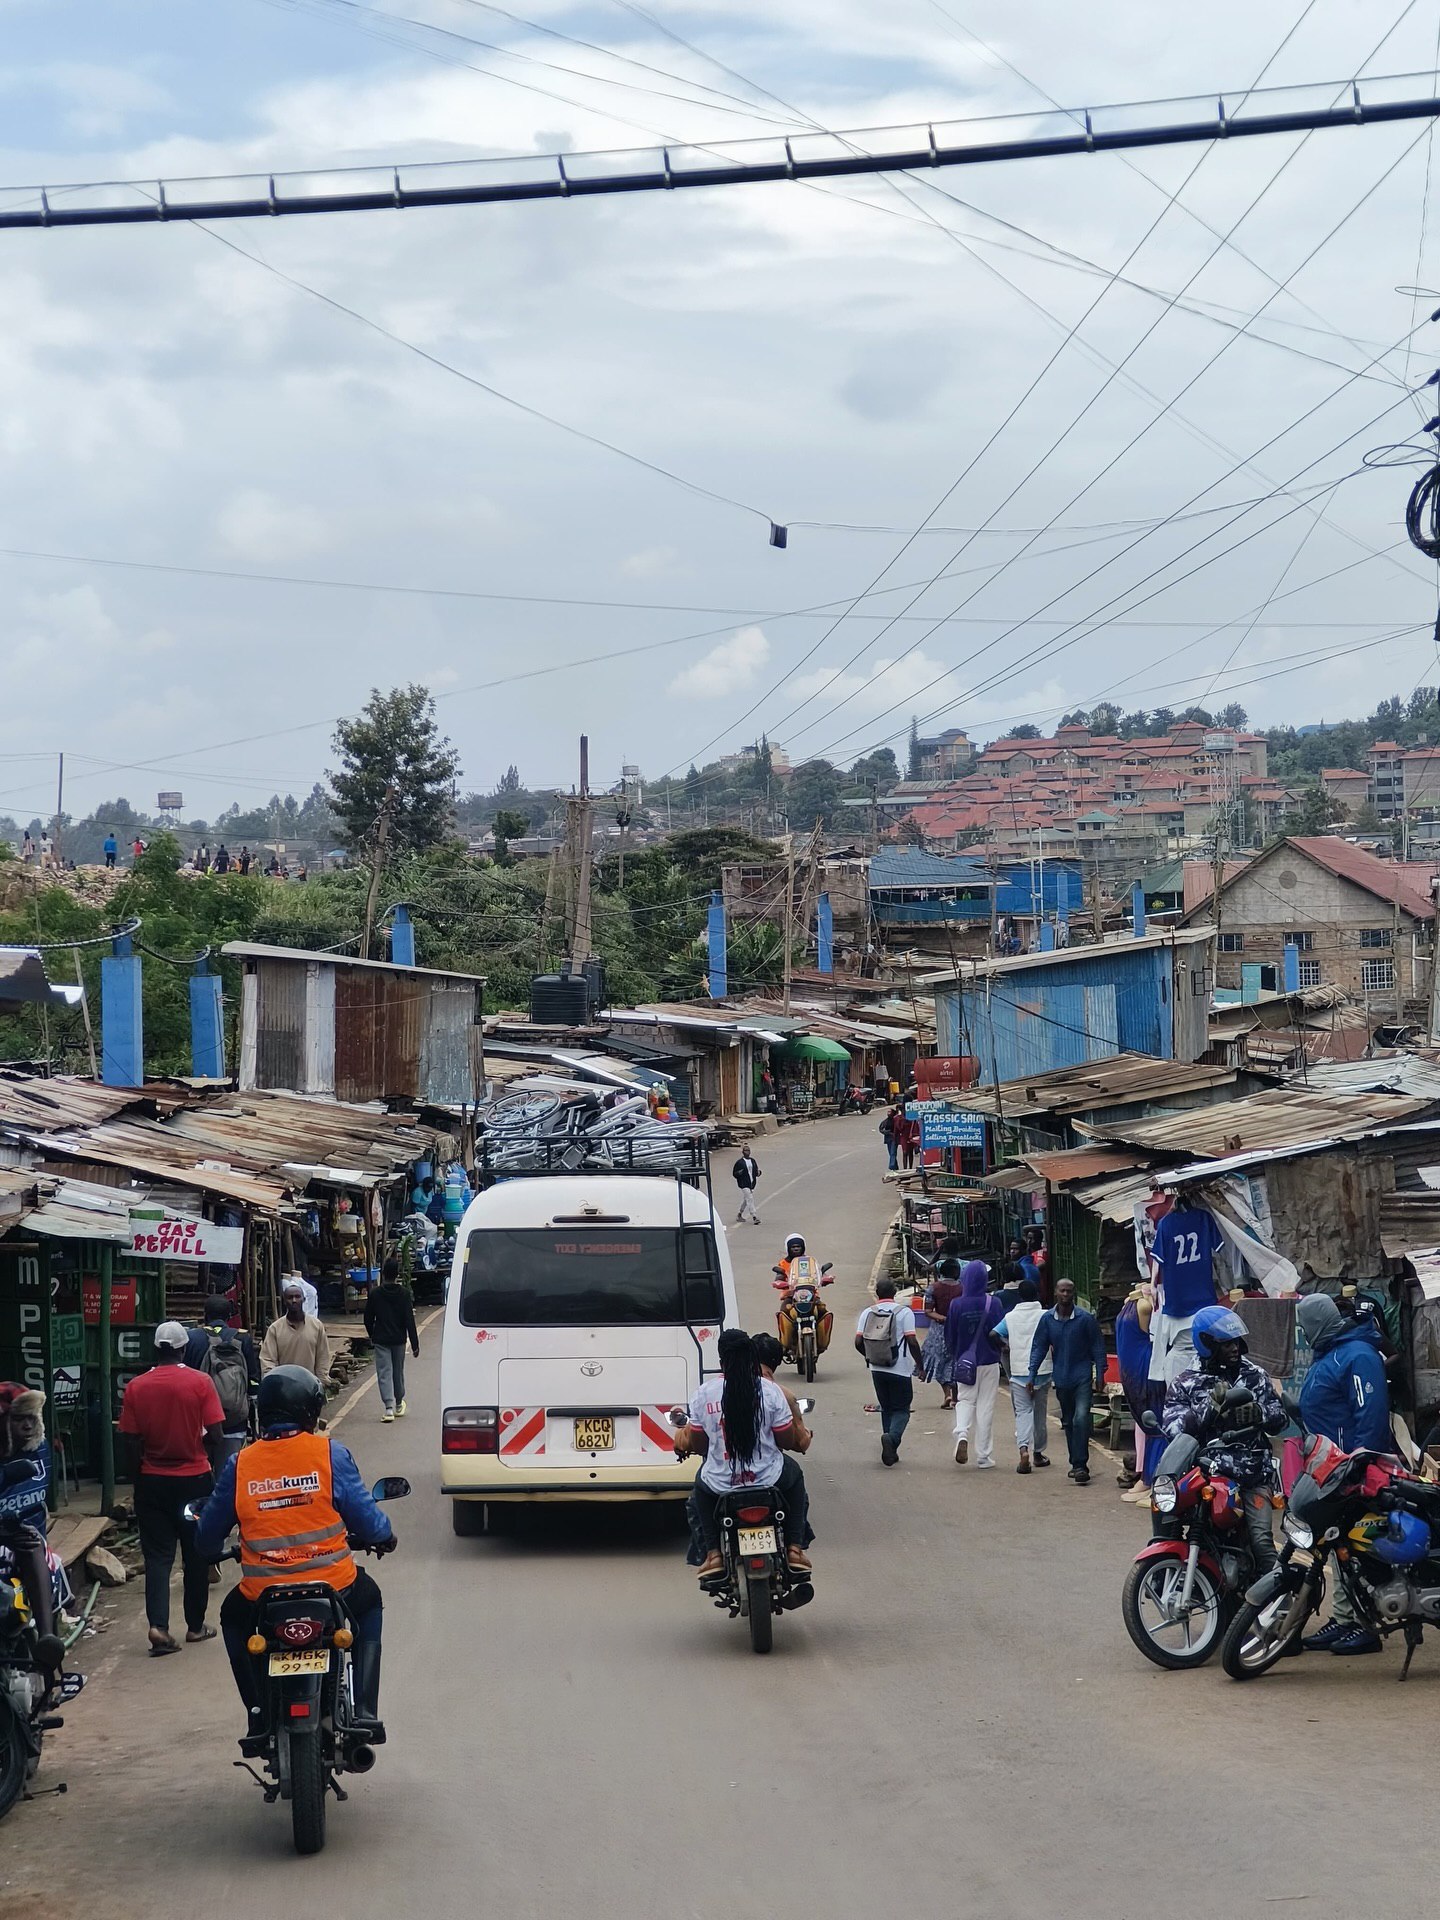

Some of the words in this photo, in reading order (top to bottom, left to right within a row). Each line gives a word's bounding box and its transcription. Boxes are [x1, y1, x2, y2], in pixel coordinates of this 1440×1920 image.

[924, 1113, 960, 1124] CLASSIC
[157, 1222, 198, 1238] GAS
[1174, 1231, 1201, 1265] 22
[585, 1419, 610, 1433] KCQ
[578, 1434, 610, 1448] 682V
[249, 1472, 318, 1494] Pakakumi
[740, 1530, 771, 1541] KMGA
